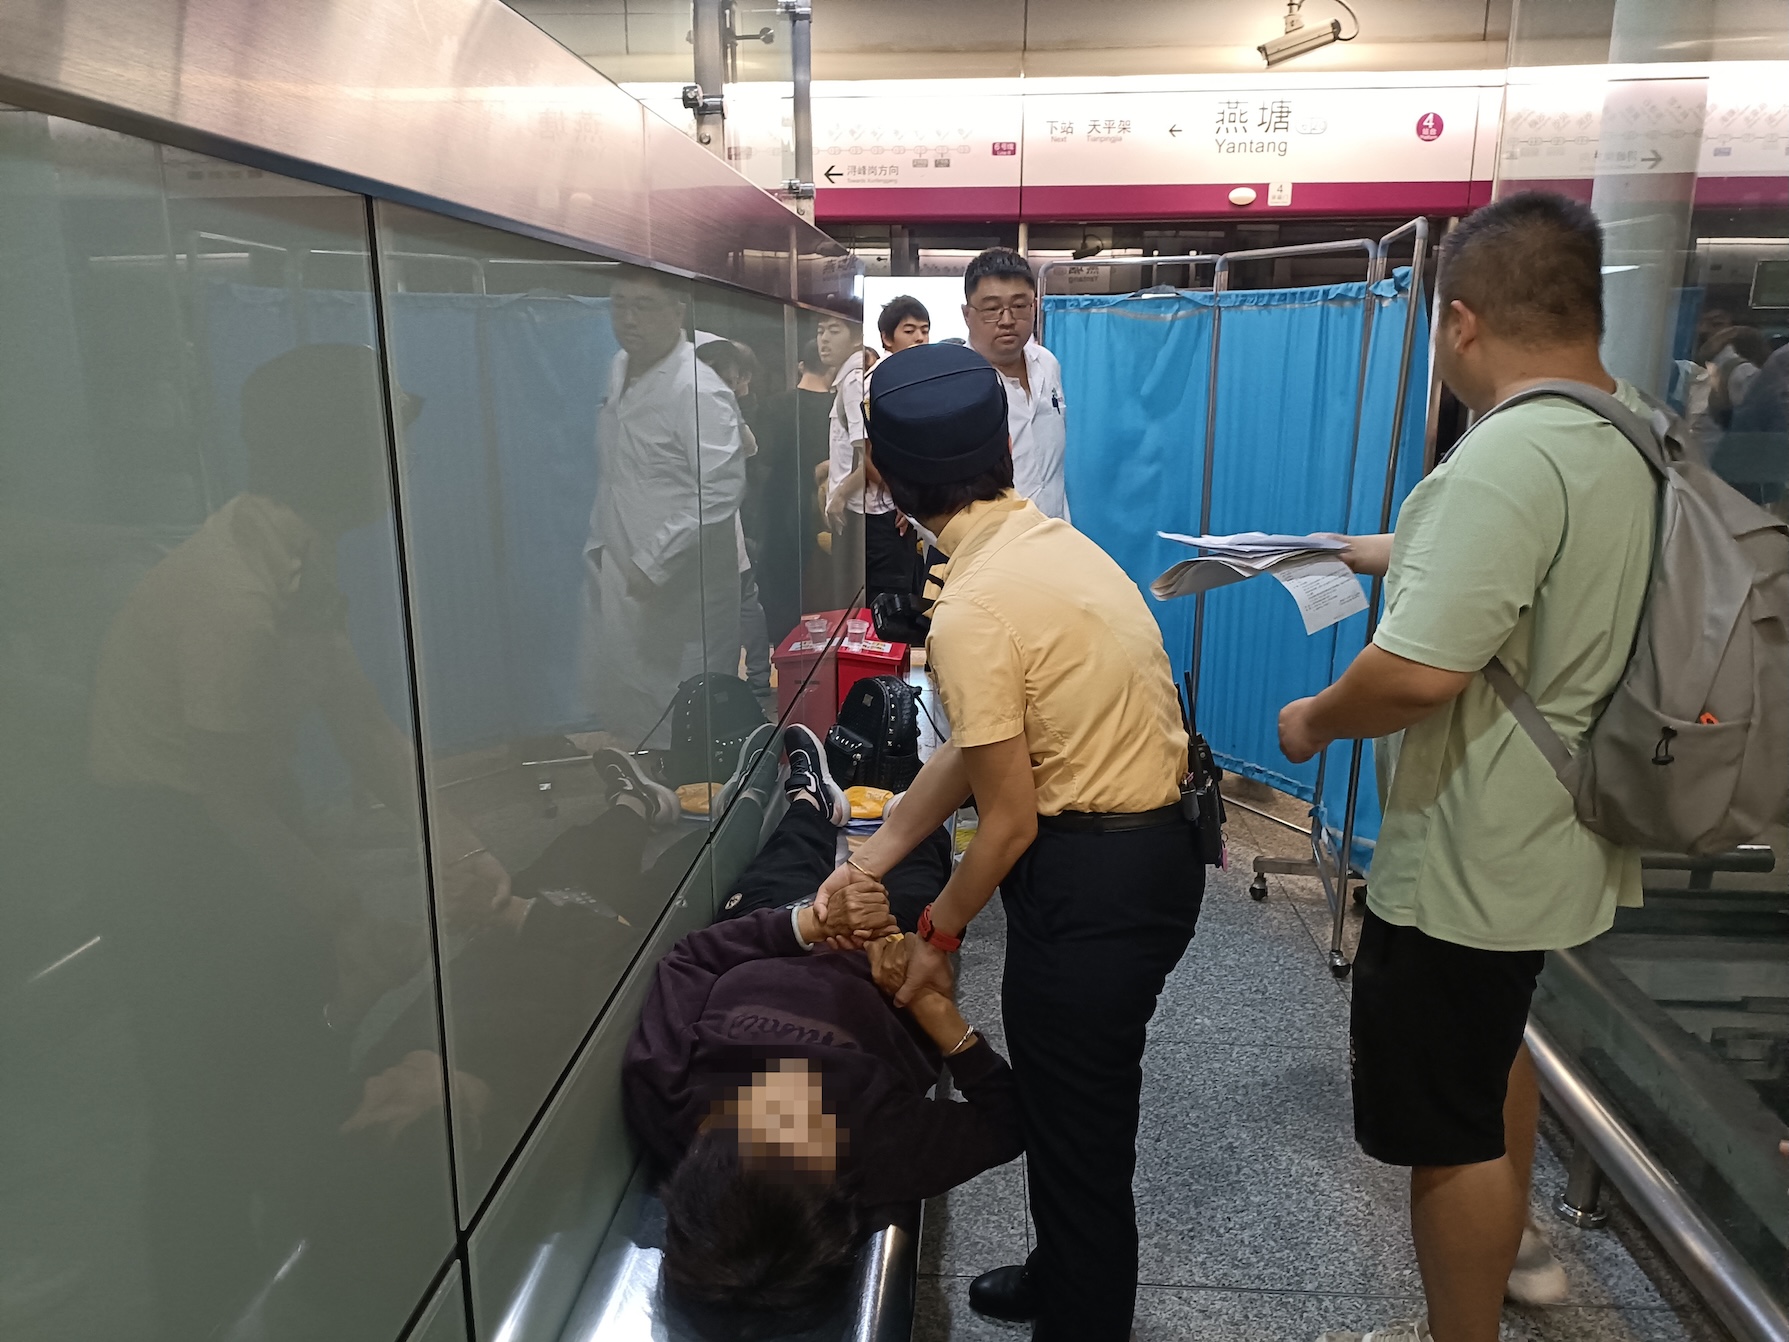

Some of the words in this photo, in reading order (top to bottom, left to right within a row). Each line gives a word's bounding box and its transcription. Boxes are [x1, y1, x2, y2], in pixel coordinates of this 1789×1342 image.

[1215, 100, 1292, 135] 燕塘
[1422, 113, 1435, 128] 4
[1046, 120, 1074, 135] 下站
[1087, 119, 1132, 135] 天平架
[1215, 138, 1288, 157] Yantang
[1276, 184, 1284, 193] 4
